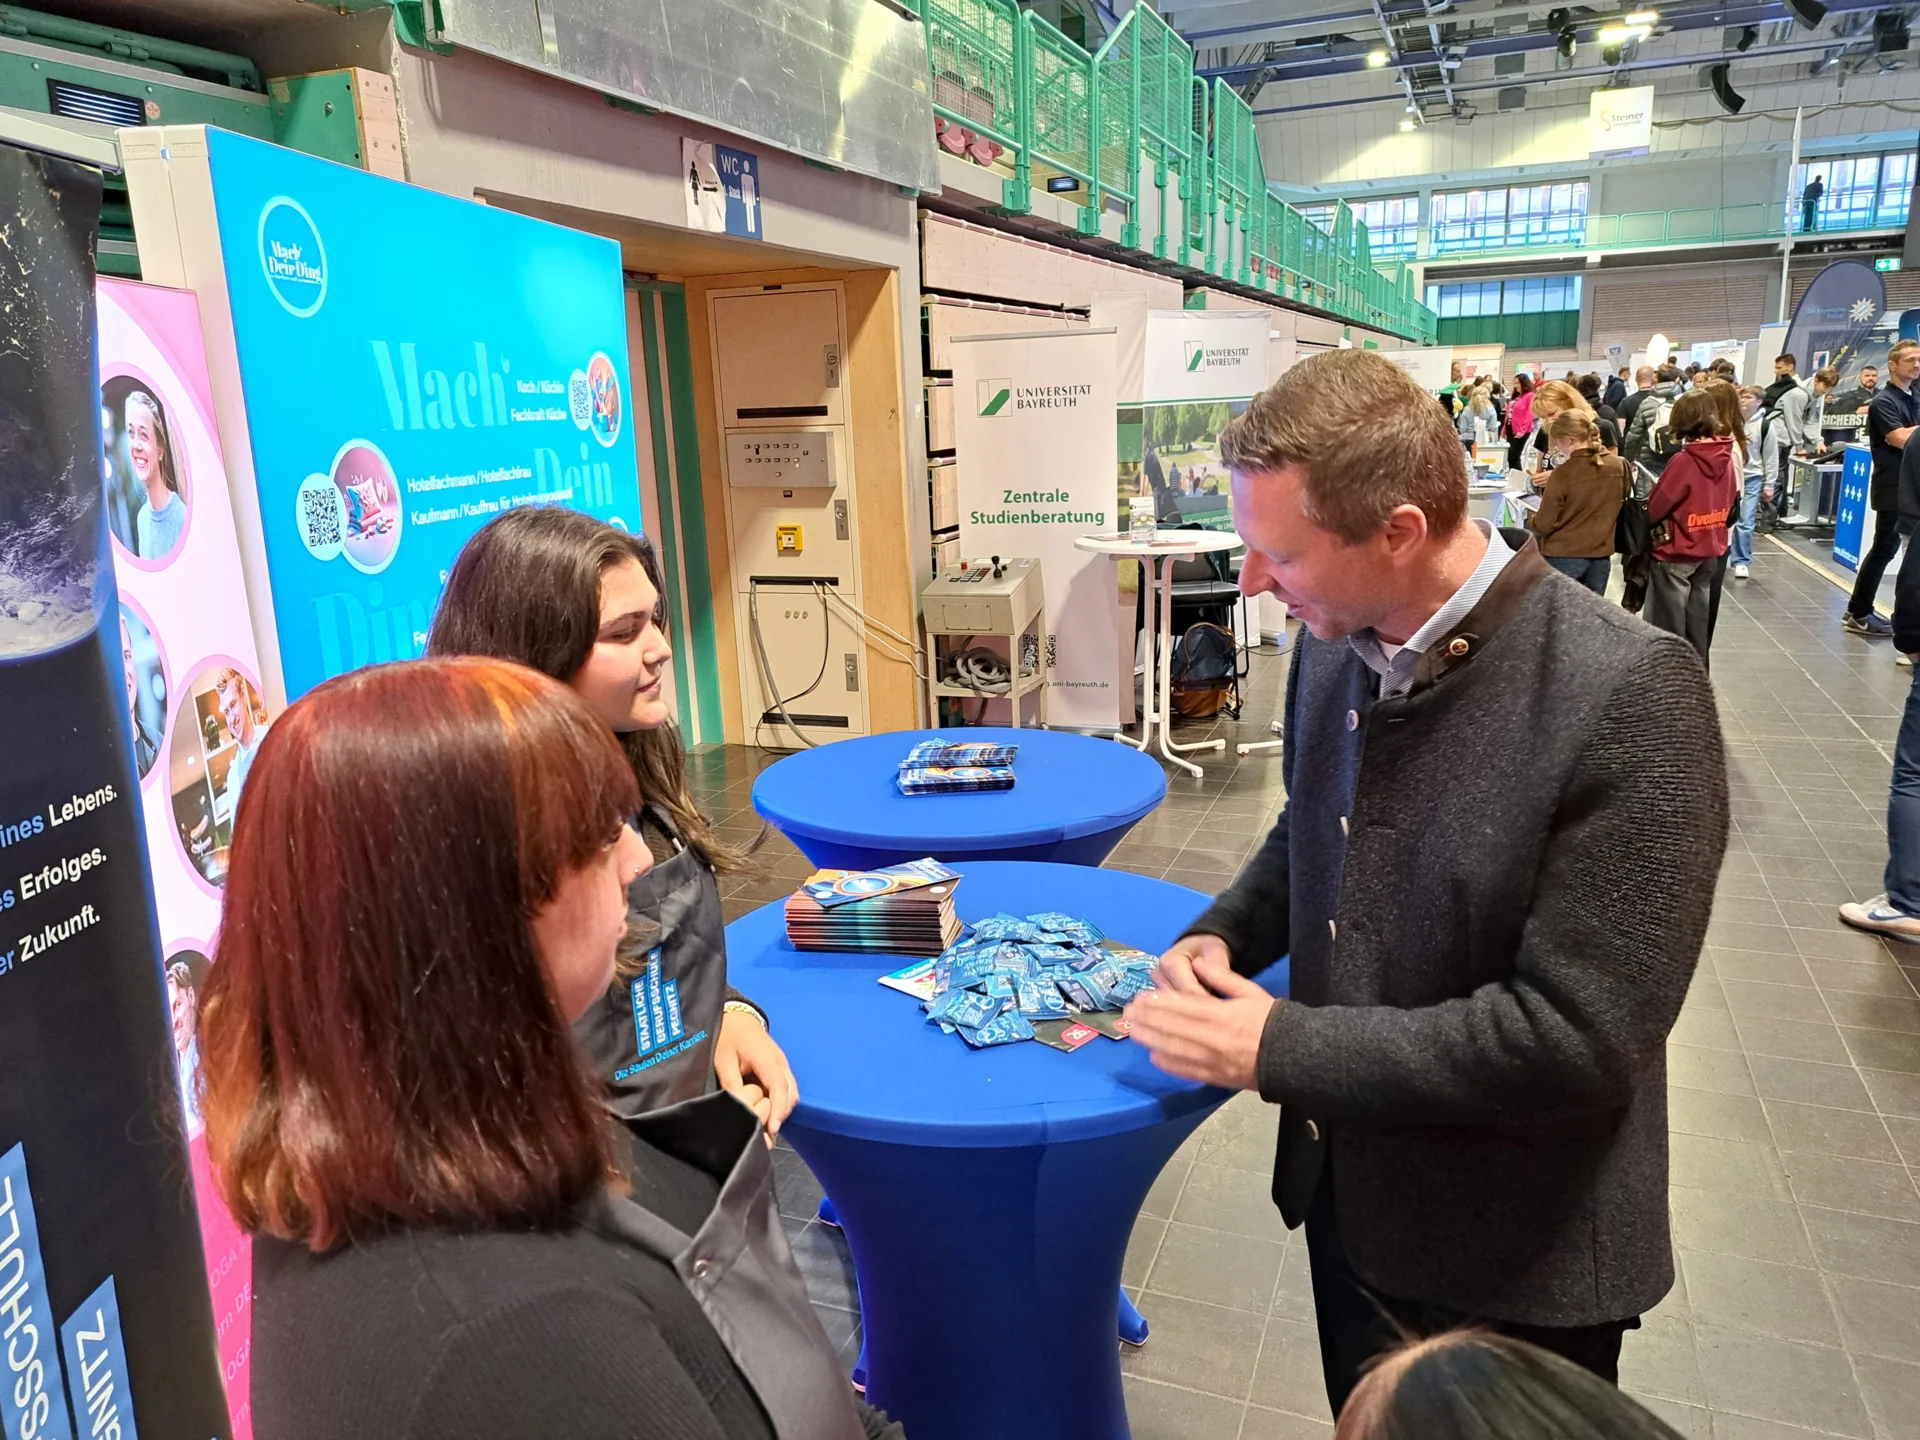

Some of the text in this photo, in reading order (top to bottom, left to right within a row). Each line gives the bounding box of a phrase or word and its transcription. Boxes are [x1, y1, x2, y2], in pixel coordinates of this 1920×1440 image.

[1611, 112, 1644, 122] Steiner
[720, 154, 740, 176] WC
[1204, 347, 1250, 357] UNIVERSITÄT
[1206, 357, 1241, 367] BAYREUTH
[1016, 384, 1092, 398] UNIVERSITÄT
[1017, 397, 1077, 410] BAYREUTH
[533, 442, 614, 509] Dein
[1003, 488, 1070, 503] Zentrale
[411, 507, 459, 526] Kaufmann
[970, 510, 1105, 526] Studienberatung
[310, 581, 438, 680] Din
[49, 784, 118, 828] Lebens.
[20, 848, 107, 900] Erfolges.
[19, 904, 101, 962] Zukunft.
[633, 979, 652, 1051] STAATLICHE
[665, 983, 682, 1036] PEGNITZ
